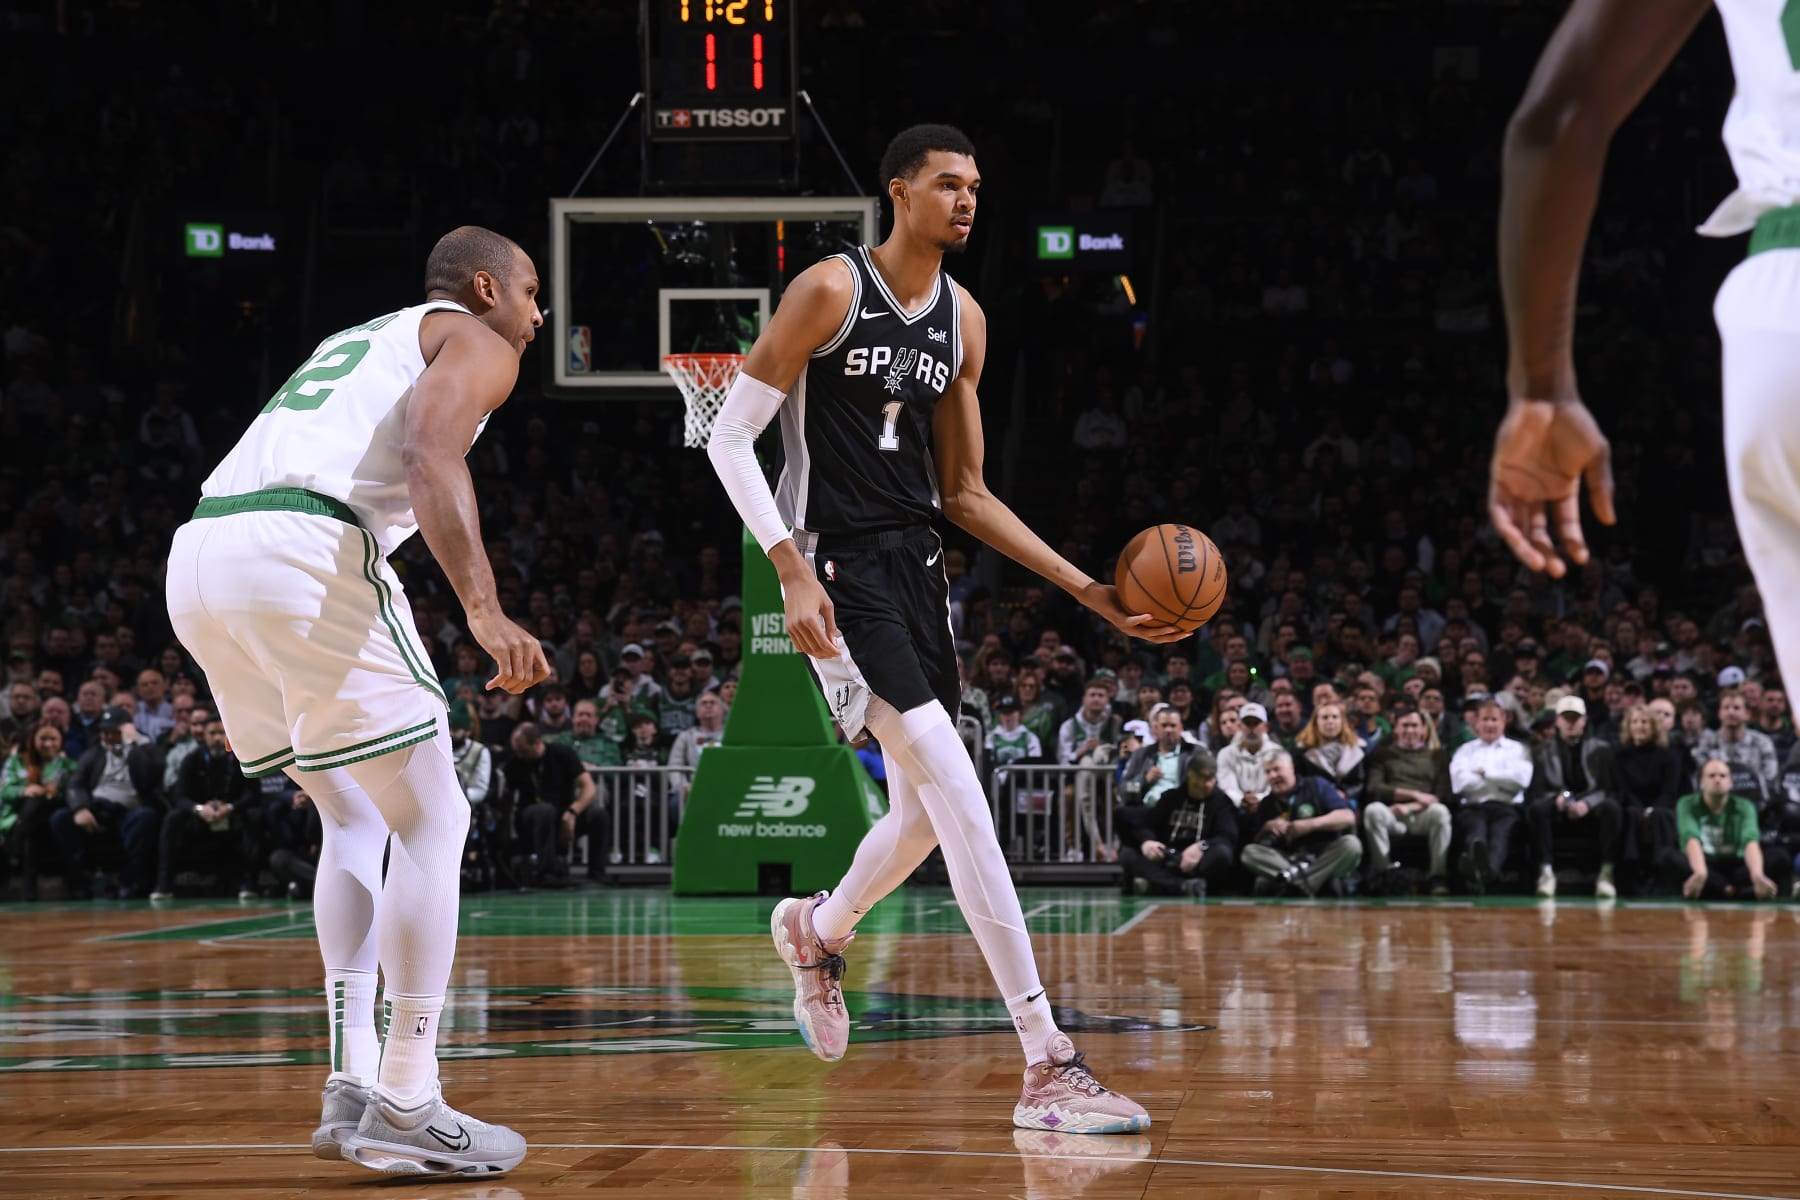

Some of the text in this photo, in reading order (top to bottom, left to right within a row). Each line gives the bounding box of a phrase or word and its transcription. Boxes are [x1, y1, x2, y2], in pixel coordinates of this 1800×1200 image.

[705, 33, 763, 90] 11
[692, 108, 786, 127] TISSOT
[190, 229, 275, 250] TD Bank
[1041, 232, 1124, 253] TD Bank
[844, 346, 949, 394] SPURS
[878, 400, 905, 451] 1
[1173, 523, 1198, 575] Wilso
[718, 821, 827, 838] new balance
